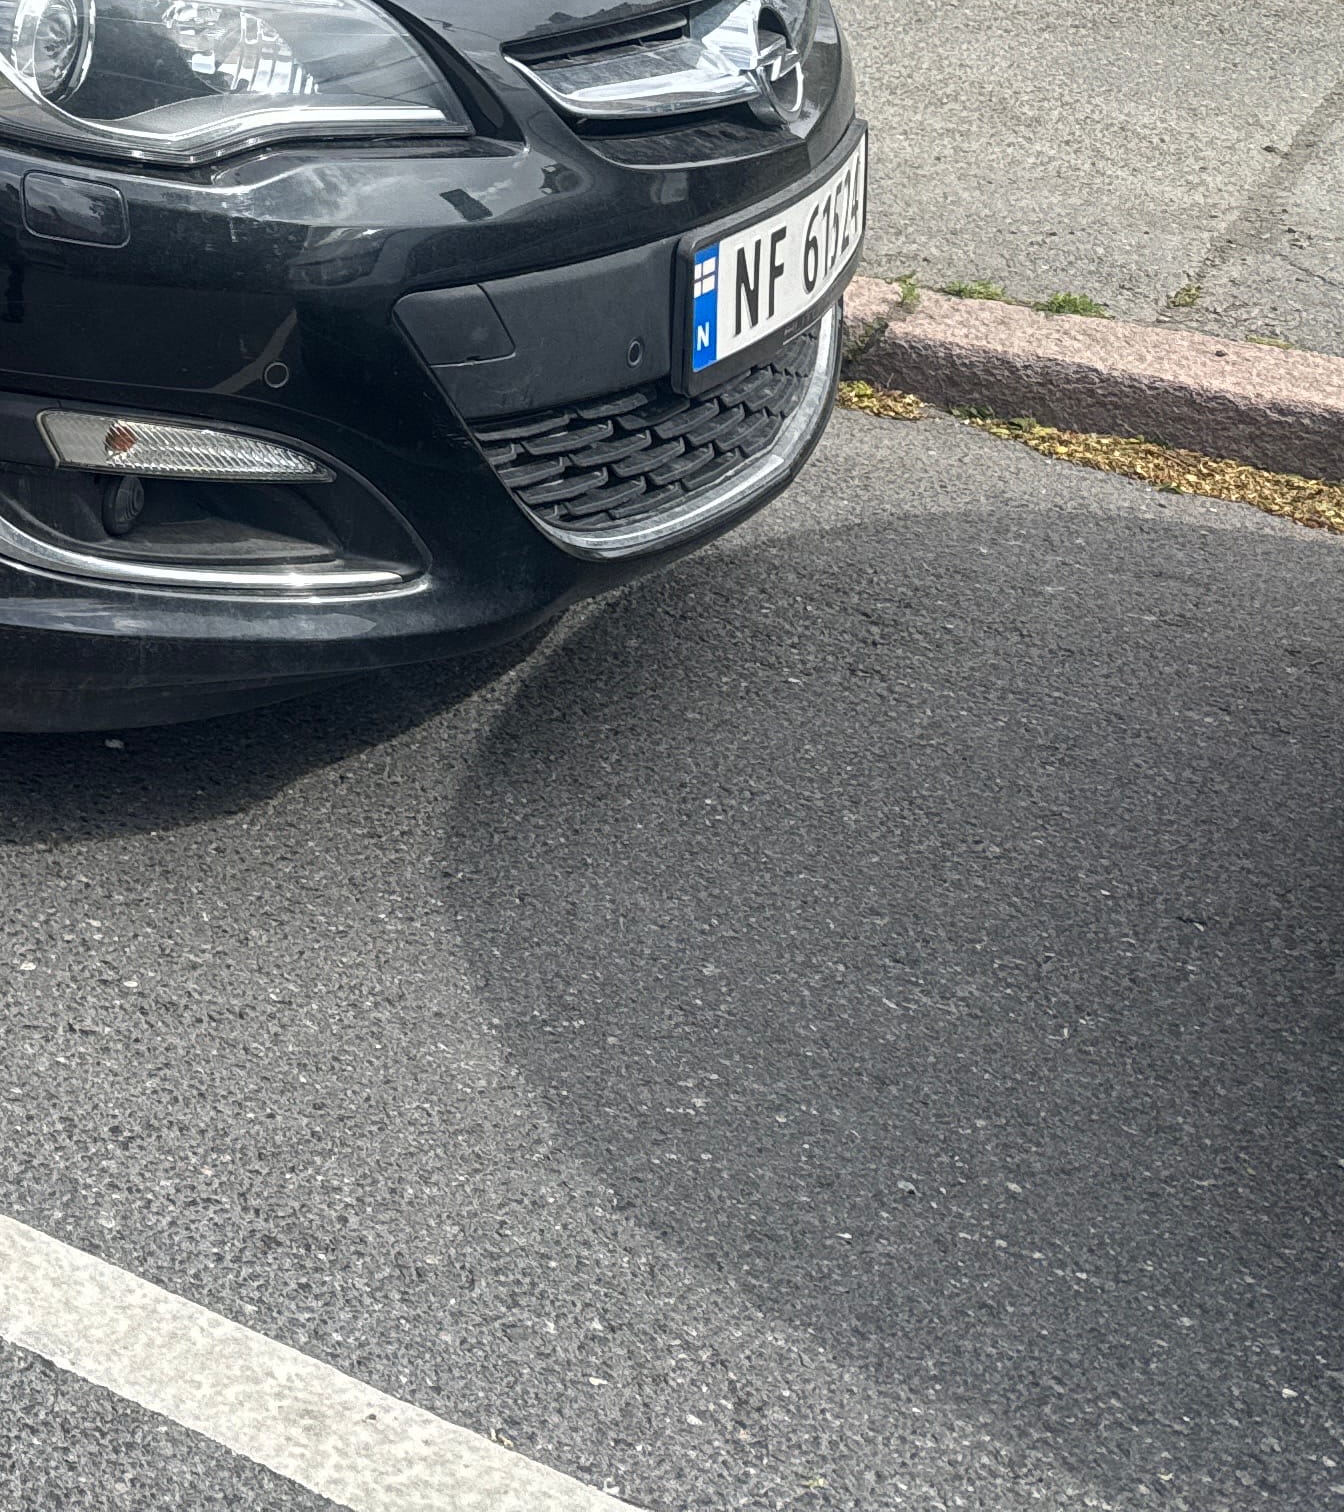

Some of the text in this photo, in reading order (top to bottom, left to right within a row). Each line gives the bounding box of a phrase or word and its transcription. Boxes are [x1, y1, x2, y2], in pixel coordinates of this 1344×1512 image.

[735, 154, 859, 337] NF 61524
[696, 322, 710, 351] N
